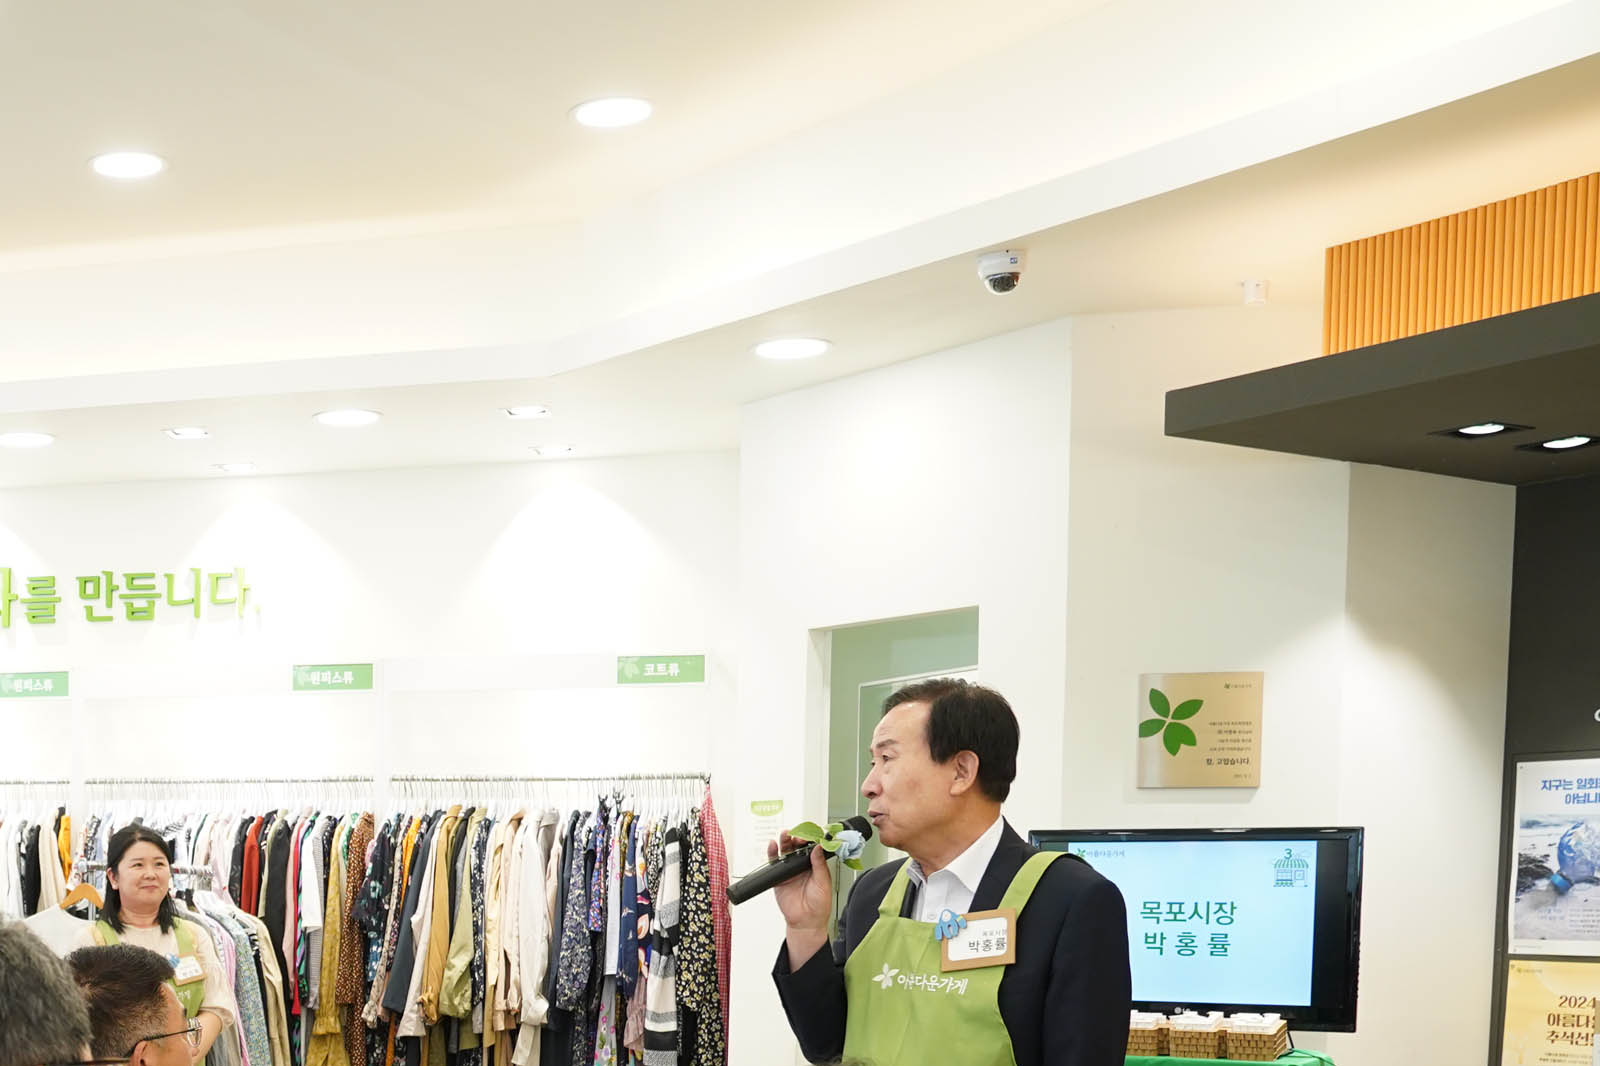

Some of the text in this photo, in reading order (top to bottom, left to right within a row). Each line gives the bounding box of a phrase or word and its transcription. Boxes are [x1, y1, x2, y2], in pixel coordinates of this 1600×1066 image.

[1541, 777, 1600, 791] 지구는 일회
[1565, 792, 1600, 805] 아닙니
[1140, 900, 1237, 926] 목포시장
[1144, 931, 1232, 958] 박 홍 률
[1558, 995, 1596, 1009] 2024
[1545, 1030, 1594, 1046] 추석선
